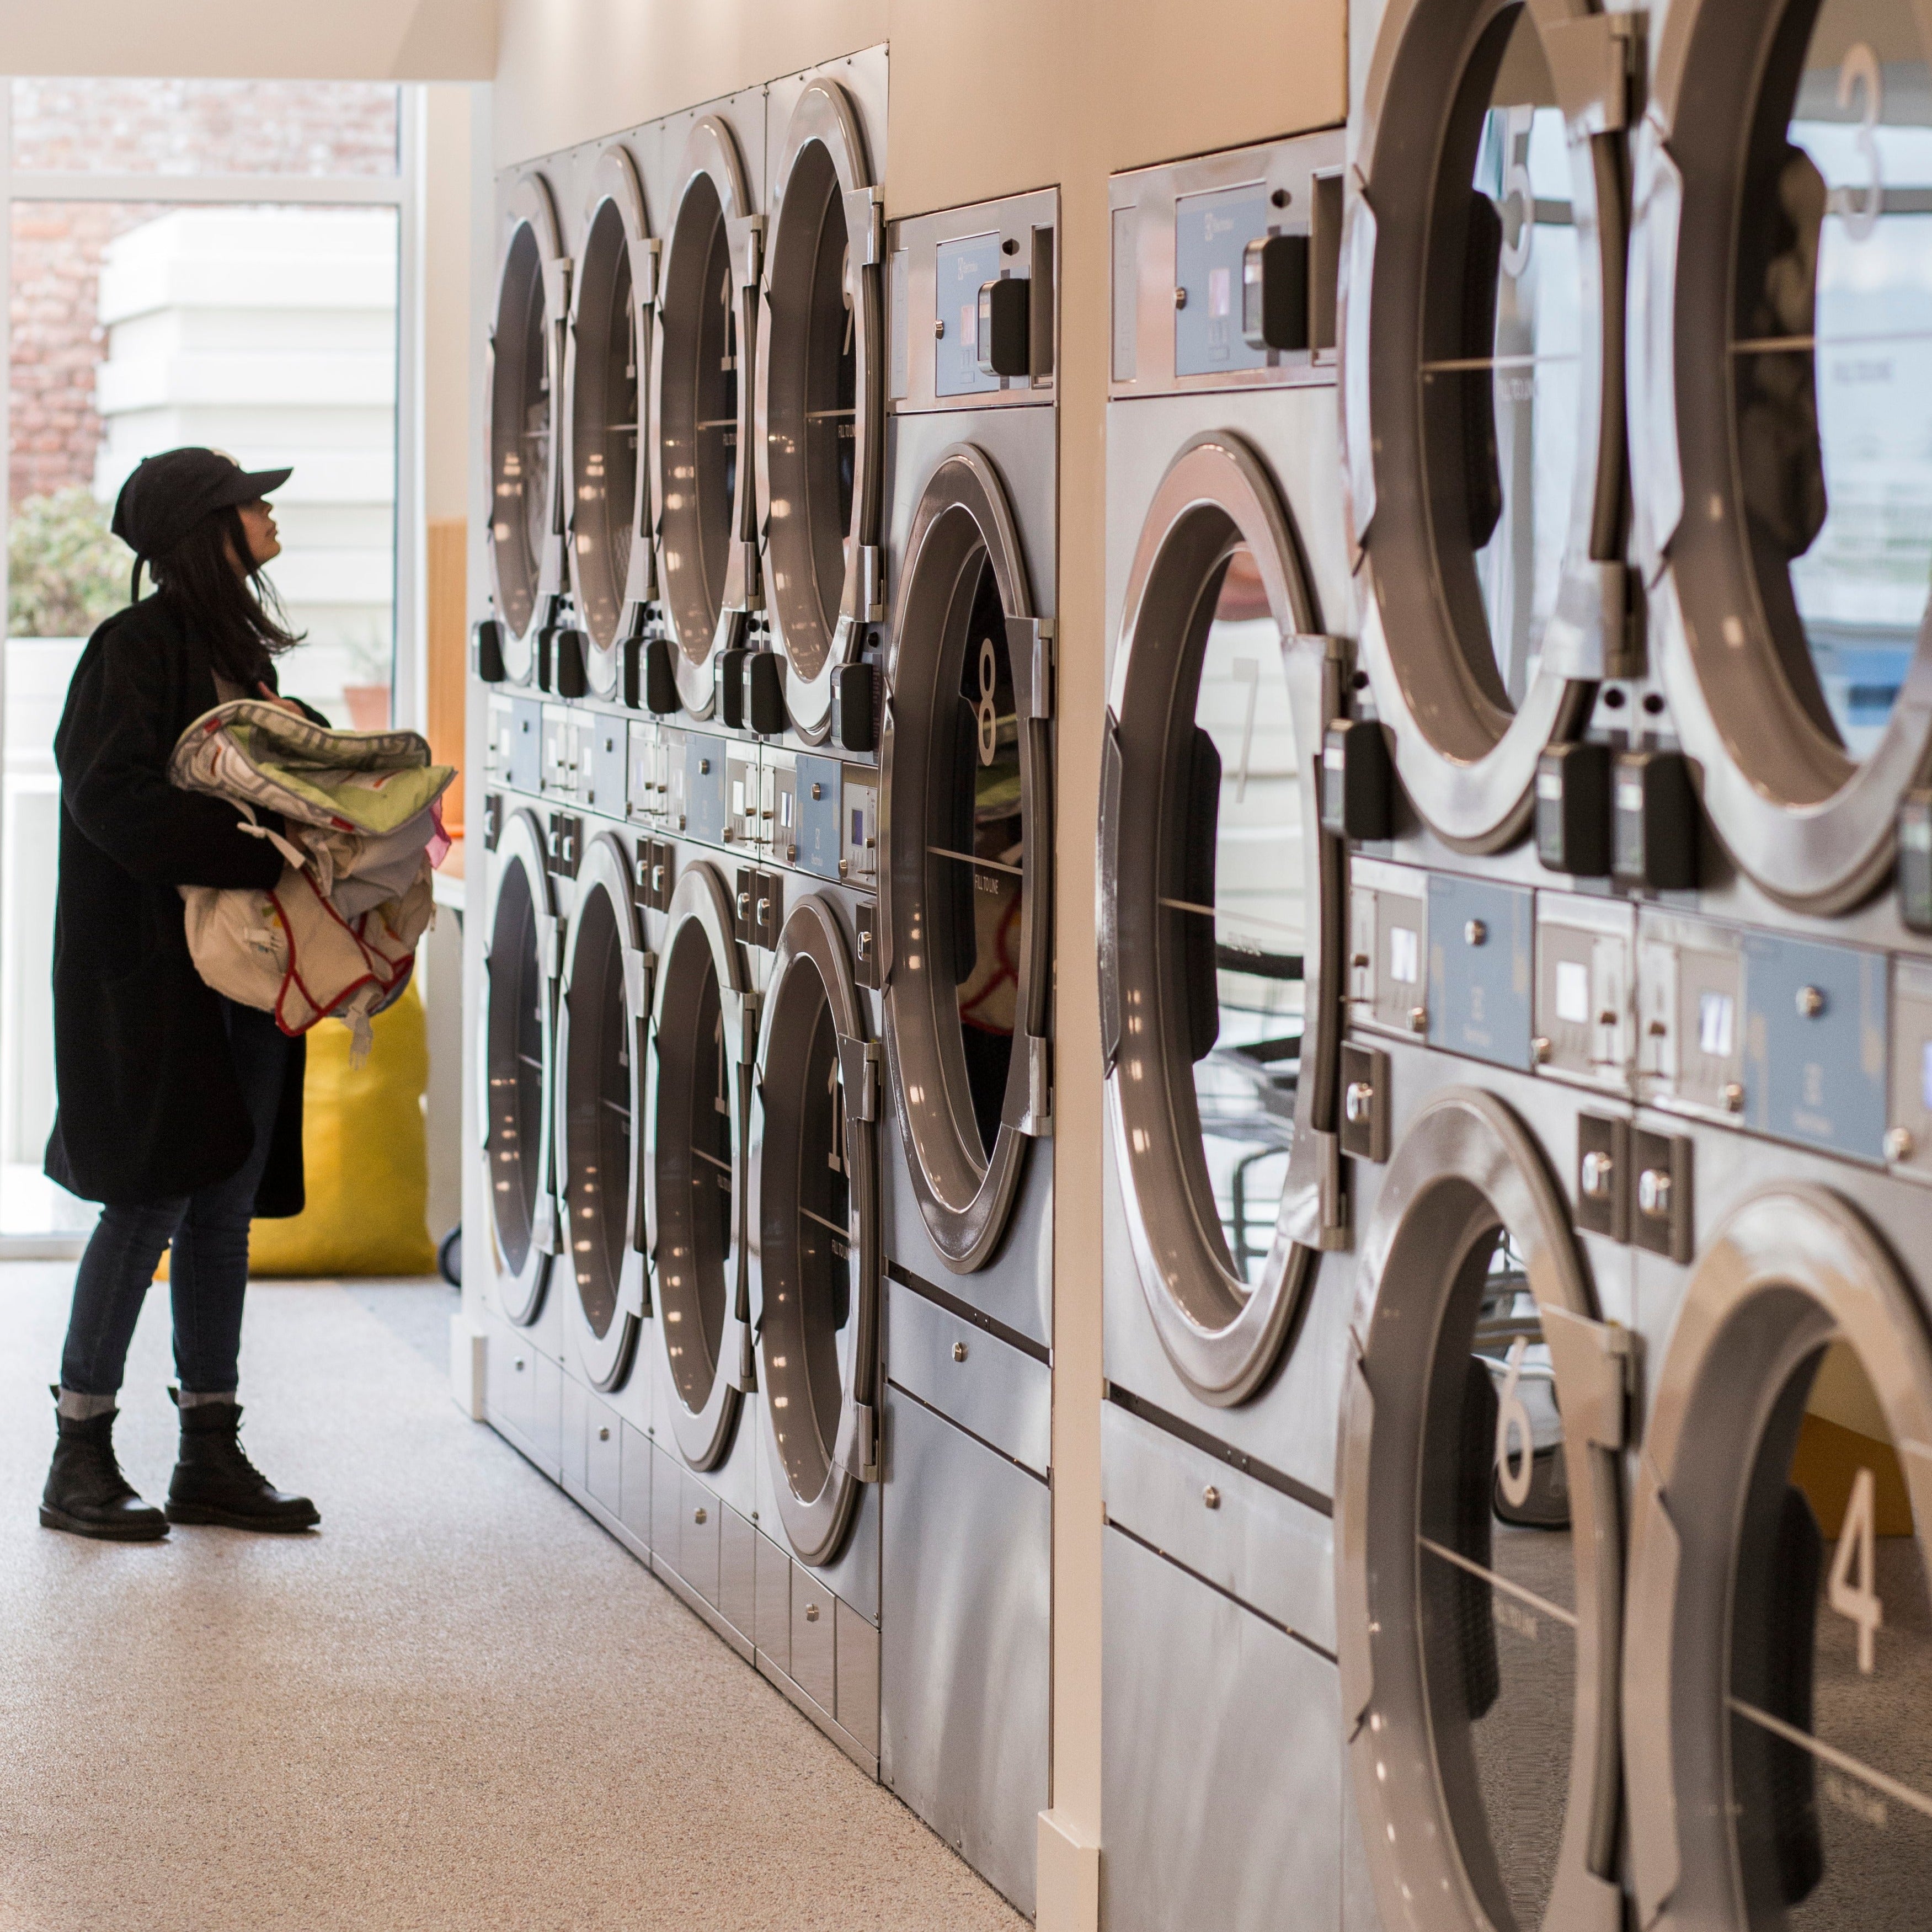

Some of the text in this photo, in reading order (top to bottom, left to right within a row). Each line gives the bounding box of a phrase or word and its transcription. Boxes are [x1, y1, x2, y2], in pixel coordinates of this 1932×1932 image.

[1501, 104, 1534, 277] 5
[1838, 43, 1880, 241] 3
[978, 638, 996, 766] 8
[1232, 658, 1259, 803] 7
[1497, 1336, 1532, 1507] 6
[1830, 1469, 1880, 1673] 4
